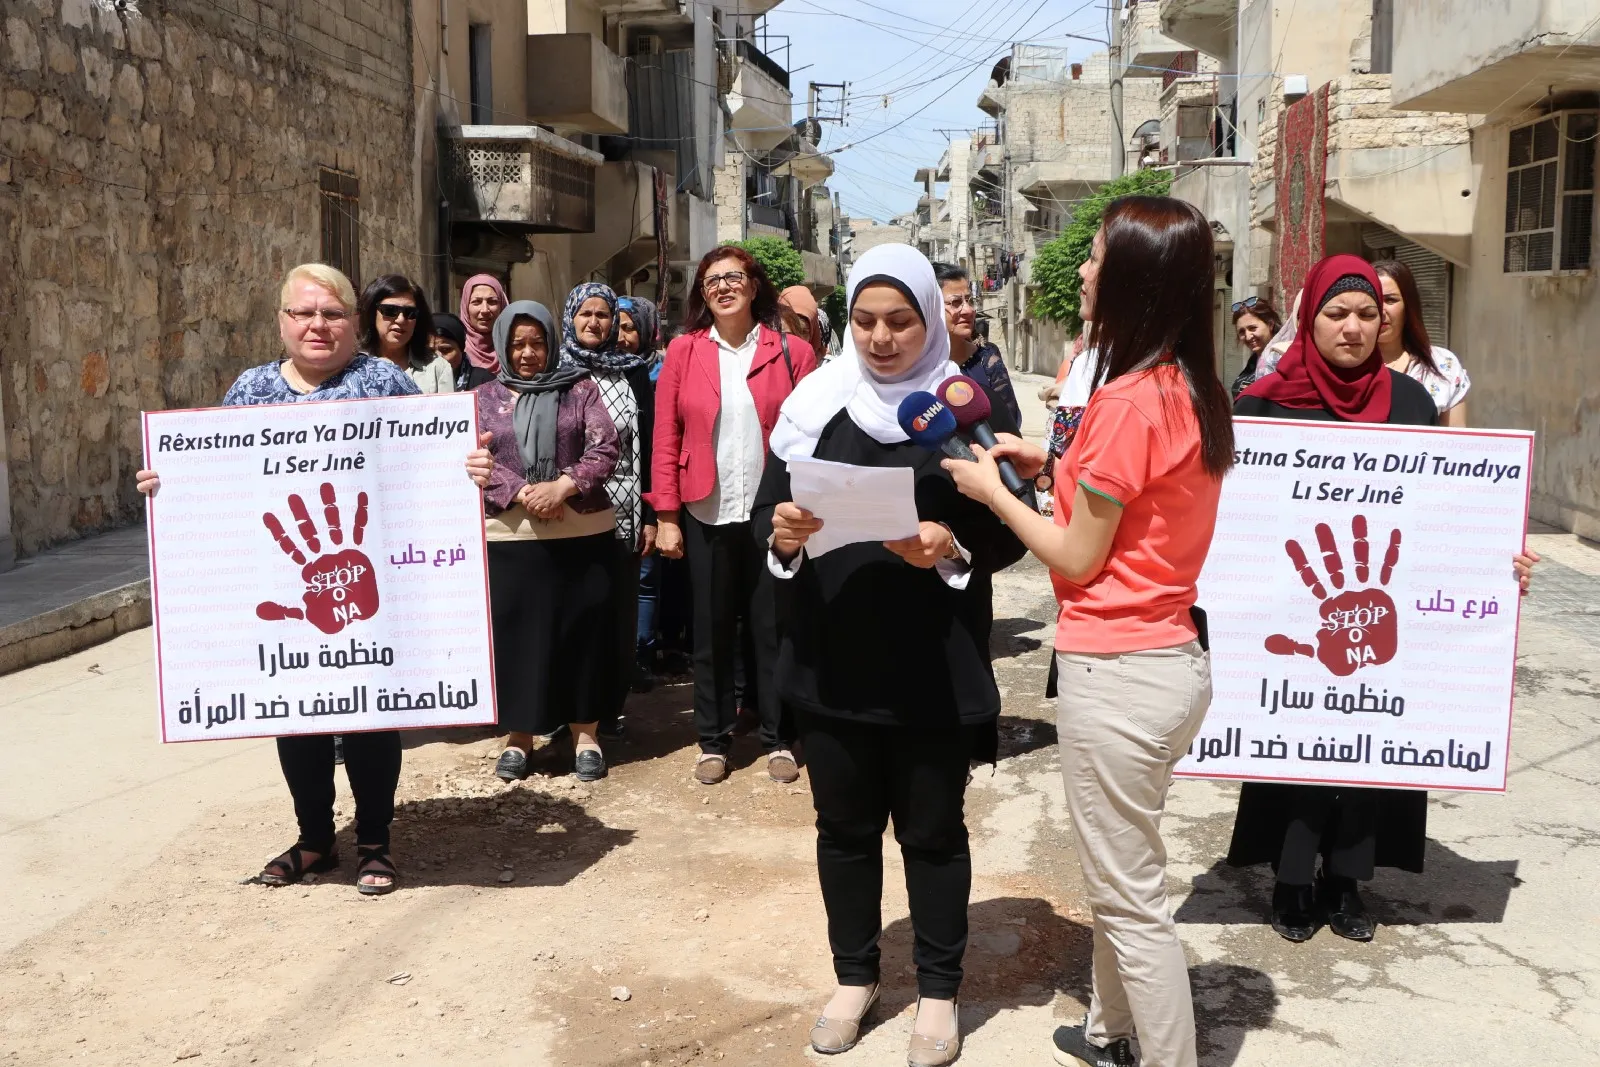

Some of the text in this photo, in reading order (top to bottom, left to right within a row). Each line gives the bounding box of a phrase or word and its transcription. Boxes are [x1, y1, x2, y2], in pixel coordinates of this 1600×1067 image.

[917, 401, 945, 428] ANHA
[261, 428, 307, 446] Sara
[314, 425, 336, 442] Ya
[286, 456, 318, 473] Ser
[1293, 449, 1345, 469] Sara
[1353, 453, 1377, 471] Ya
[1317, 482, 1354, 501] Ser
[390, 544, 426, 569] حلب
[433, 544, 465, 567] فرع
[310, 564, 367, 594] STOP
[333, 603, 361, 622] NA
[1416, 590, 1498, 619] فرع حلب
[1327, 605, 1388, 632] STOP
[259, 639, 393, 677] منظمة سارا
[1345, 647, 1377, 664] NA
[179, 679, 477, 729] لمناهضة العنف ضد المرأة
[1261, 678, 1404, 716] منظمة سارا
[1251, 735, 1287, 759] ضد
[1298, 734, 1371, 763] العنف
[1382, 739, 1490, 772] لمناهضة
